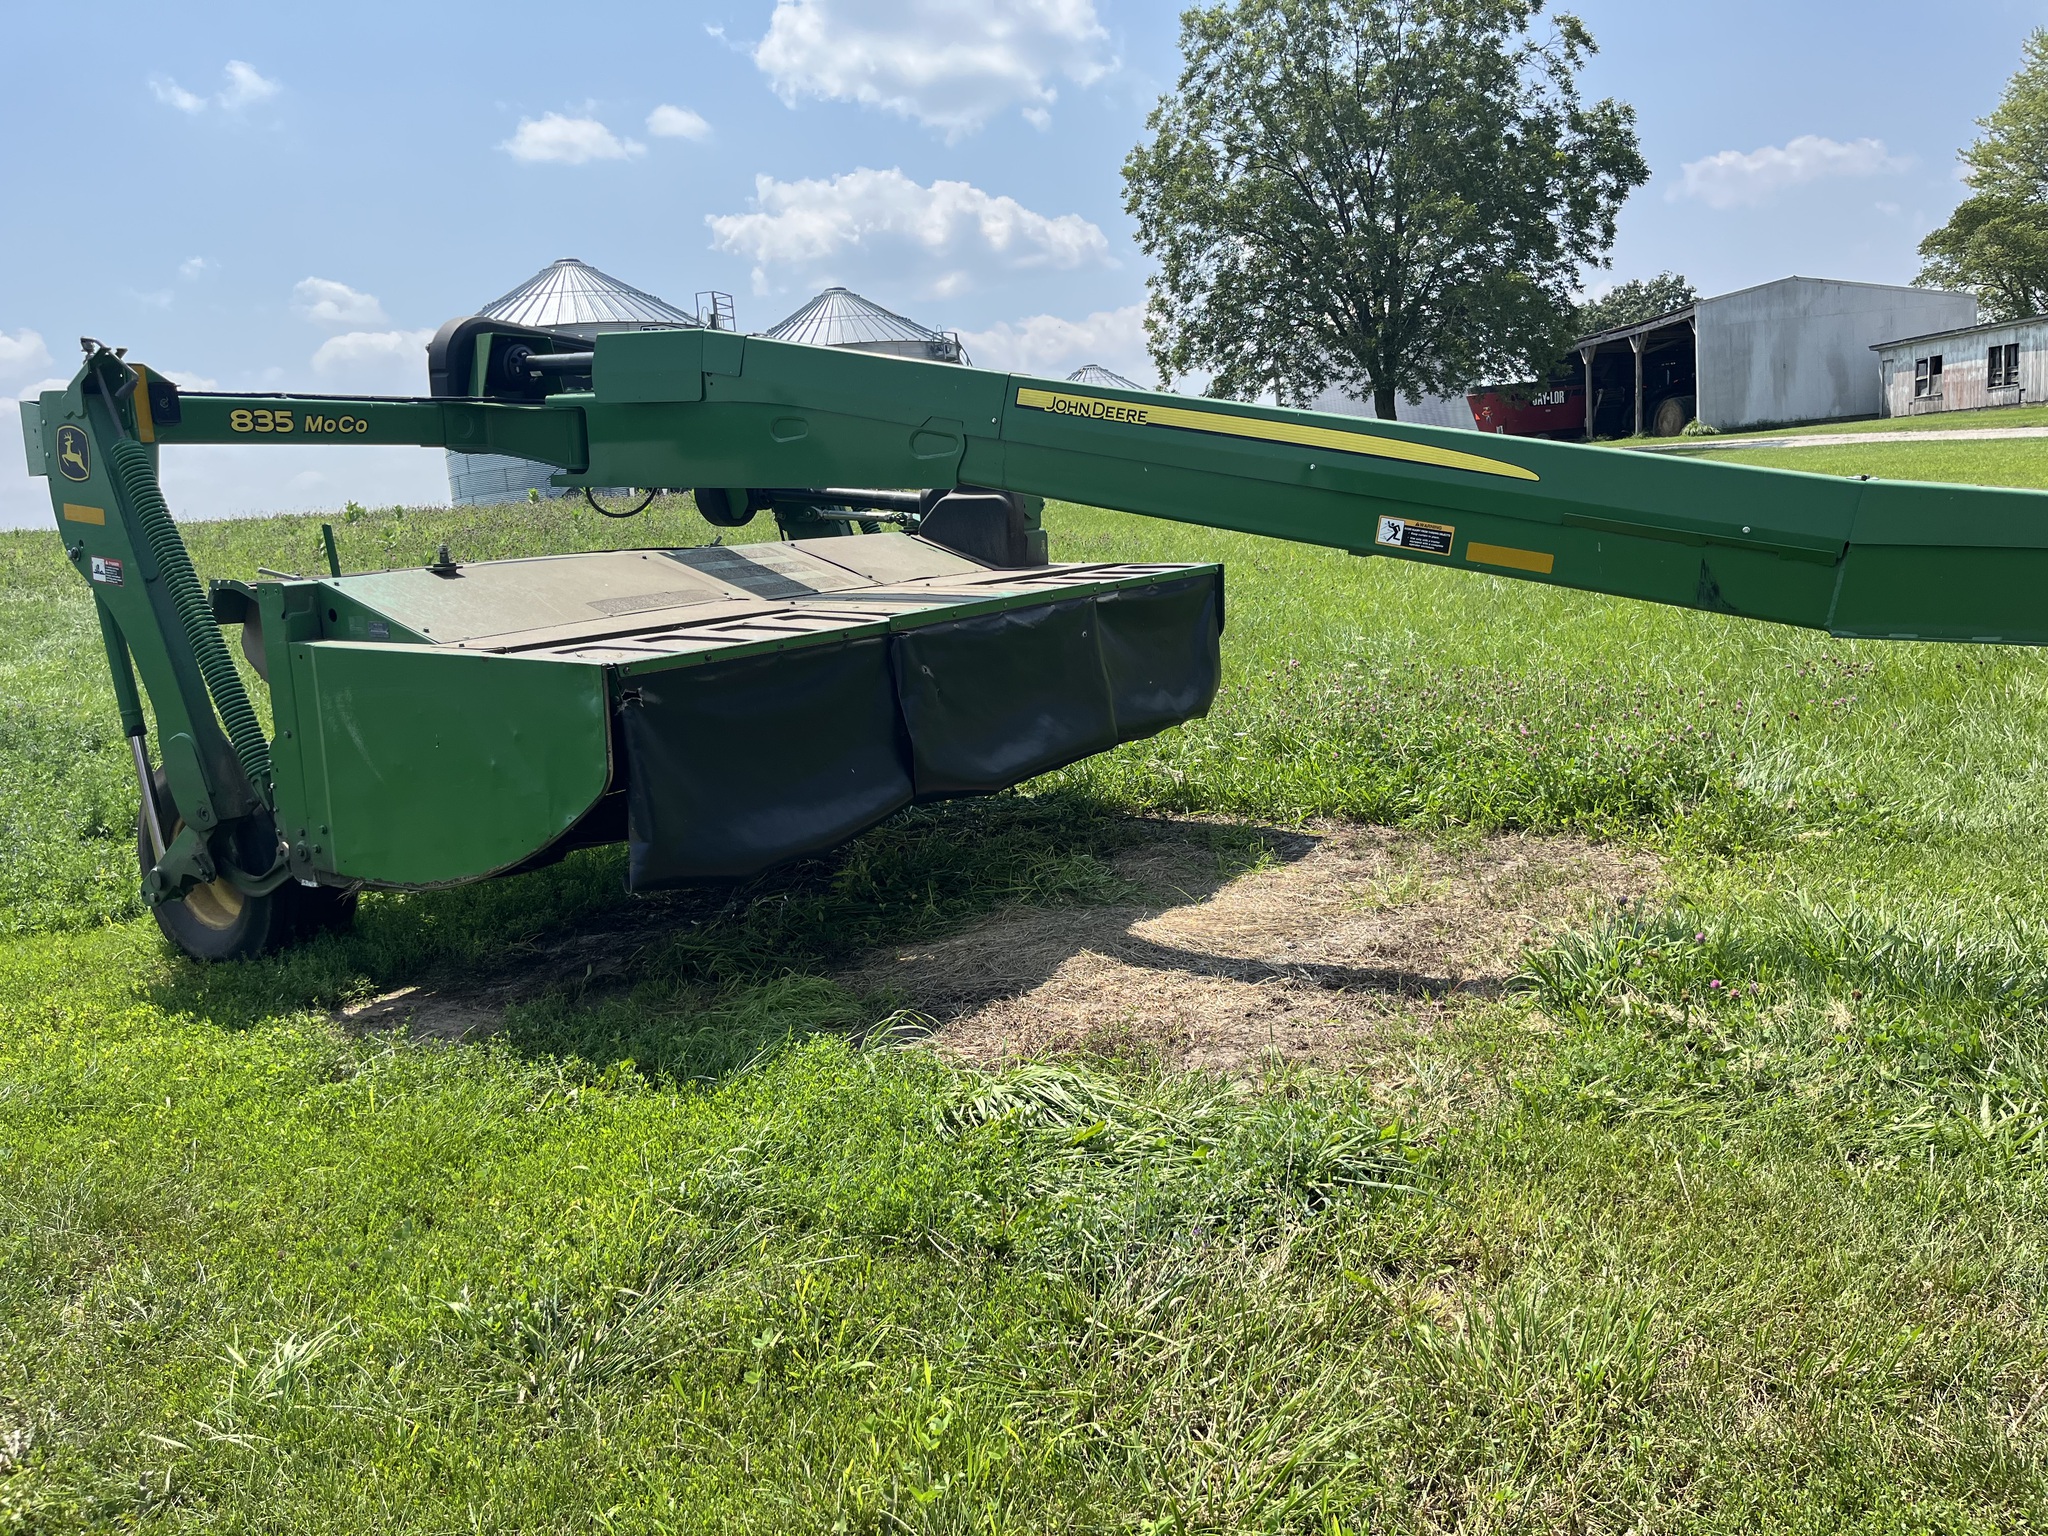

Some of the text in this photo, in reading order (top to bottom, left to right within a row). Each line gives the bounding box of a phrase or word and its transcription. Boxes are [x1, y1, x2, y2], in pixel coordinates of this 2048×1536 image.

[229, 408, 368, 433] 835 MoCo
[1046, 396, 1148, 422] JOHN DEERE
